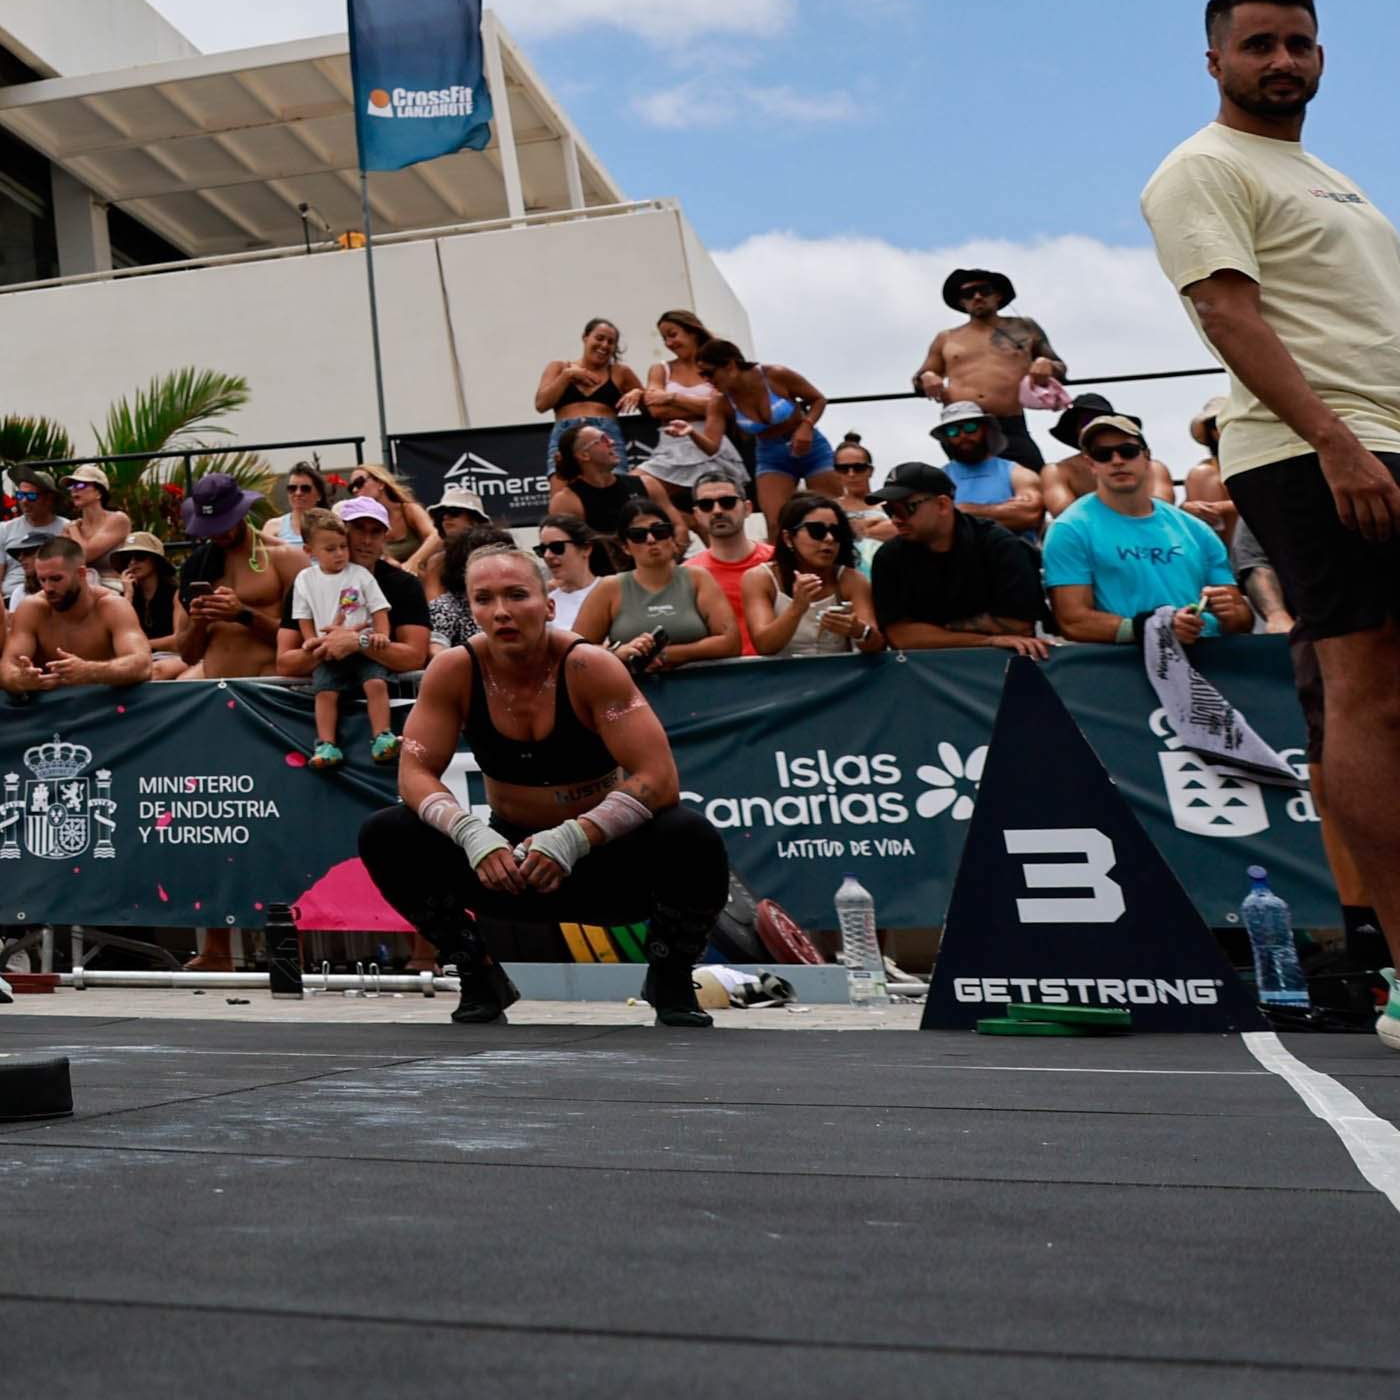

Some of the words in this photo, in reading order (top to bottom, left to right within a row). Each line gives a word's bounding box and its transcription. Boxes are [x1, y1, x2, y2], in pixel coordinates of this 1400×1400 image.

[392, 86, 473, 107] CrossFit
[397, 103, 474, 119] LANZAROTE
[774, 749, 902, 788] Islas
[138, 775, 254, 794] MINISTERIO
[139, 801, 166, 819] DE
[170, 800, 280, 819] INDUSTRIA
[138, 826, 152, 844] Y
[154, 825, 250, 844] TURISMO
[850, 839, 872, 857] DE
[874, 838, 915, 857] VIDA
[1003, 828, 1126, 923] 3
[953, 977, 1219, 1005] GETSTRONG
